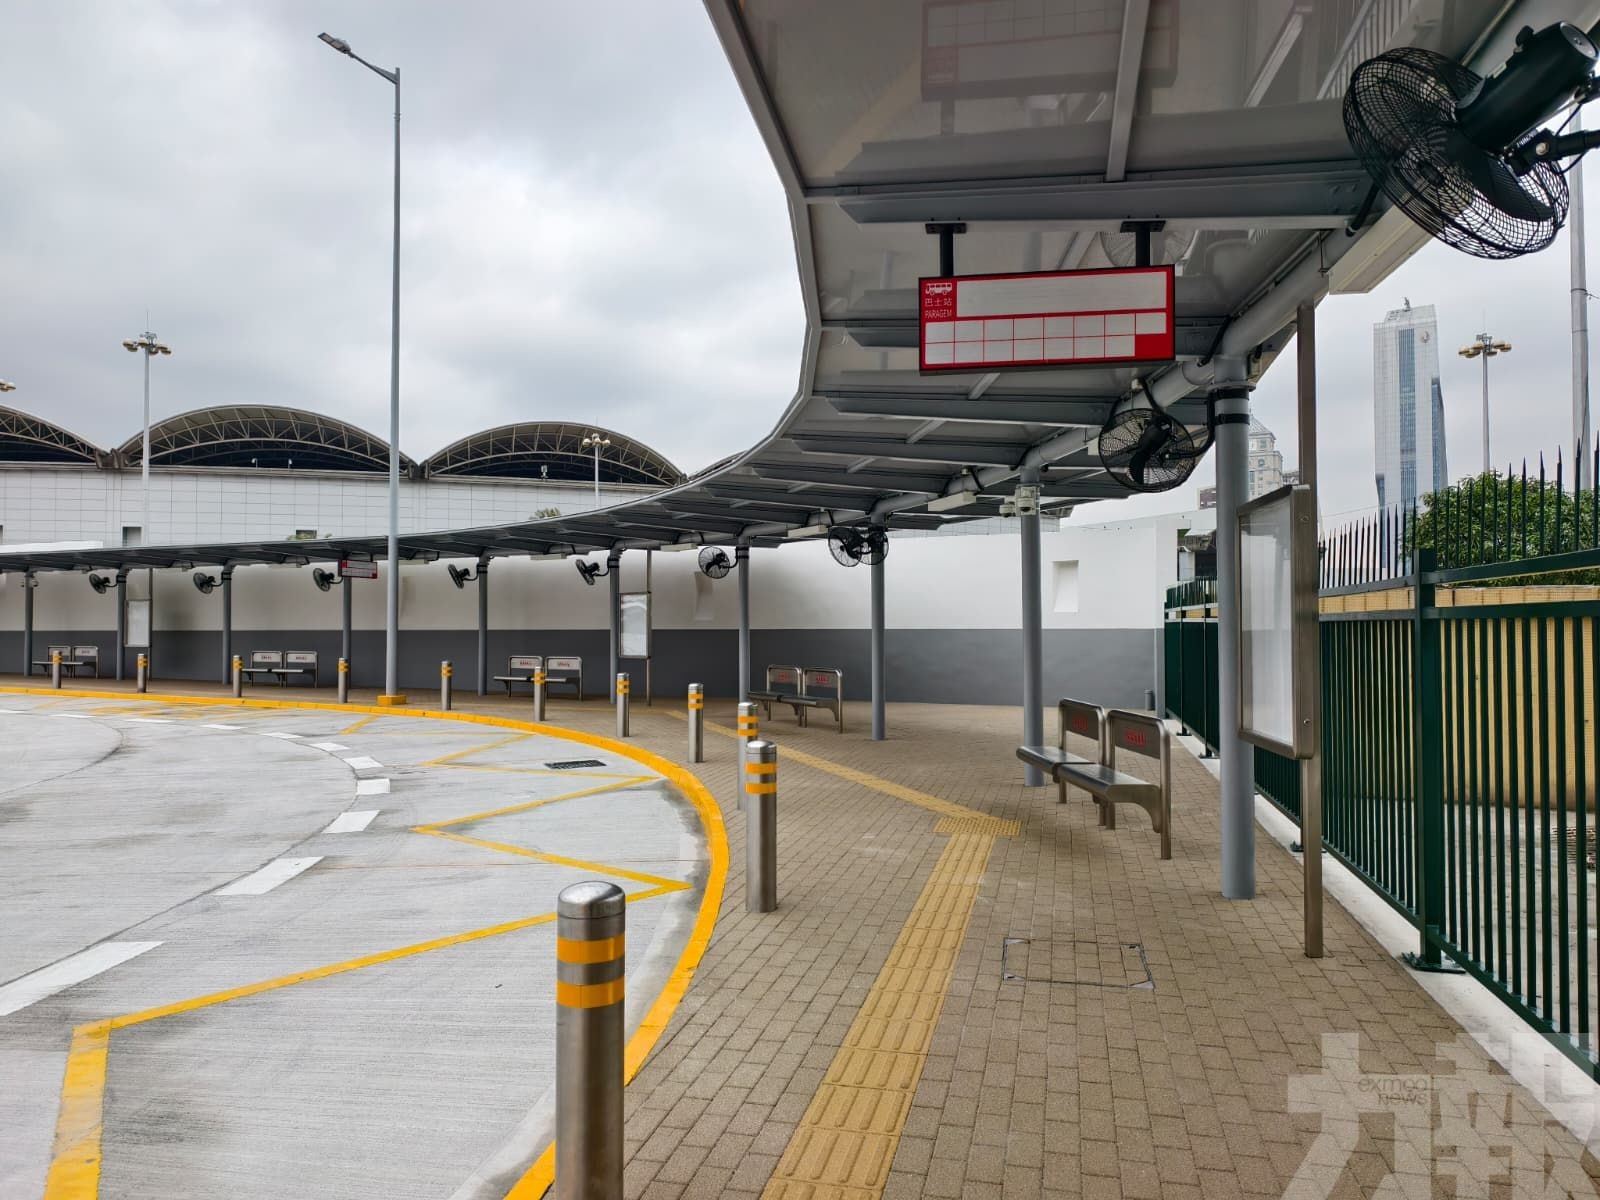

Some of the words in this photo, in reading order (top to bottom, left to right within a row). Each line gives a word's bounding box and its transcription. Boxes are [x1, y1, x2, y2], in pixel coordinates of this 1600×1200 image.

[925, 298, 952, 307] 巴士站
[925, 309, 952, 319] PARAGEM
